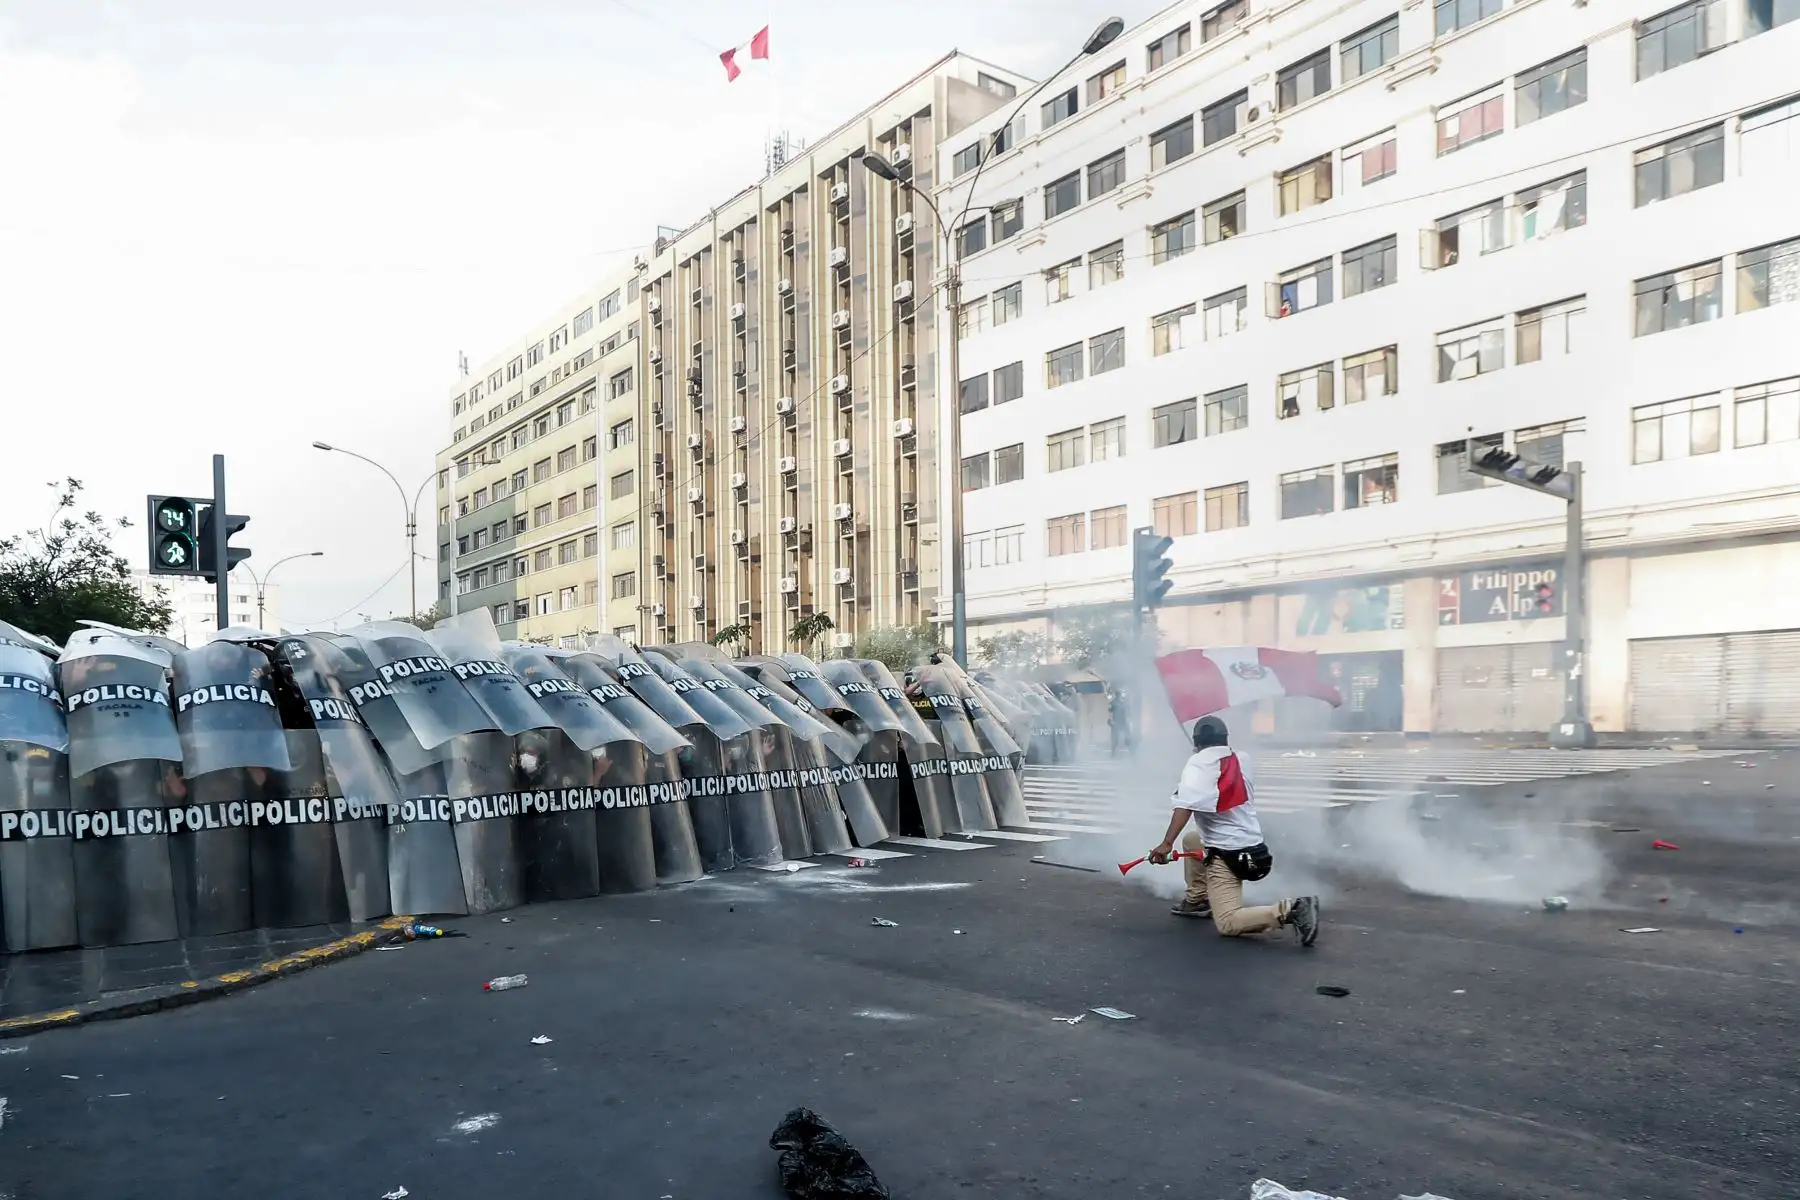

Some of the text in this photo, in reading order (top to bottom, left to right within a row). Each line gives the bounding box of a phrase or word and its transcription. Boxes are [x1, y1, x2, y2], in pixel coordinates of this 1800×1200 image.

[1471, 569, 1556, 591] Filippo
[1488, 593, 1536, 617] Alp
[68, 685, 168, 712] POLICIA
[178, 685, 275, 712] POLICIA
[454, 793, 519, 822] POLICIA
[521, 788, 594, 814] POLICIA
[75, 808, 168, 839] POLICI
